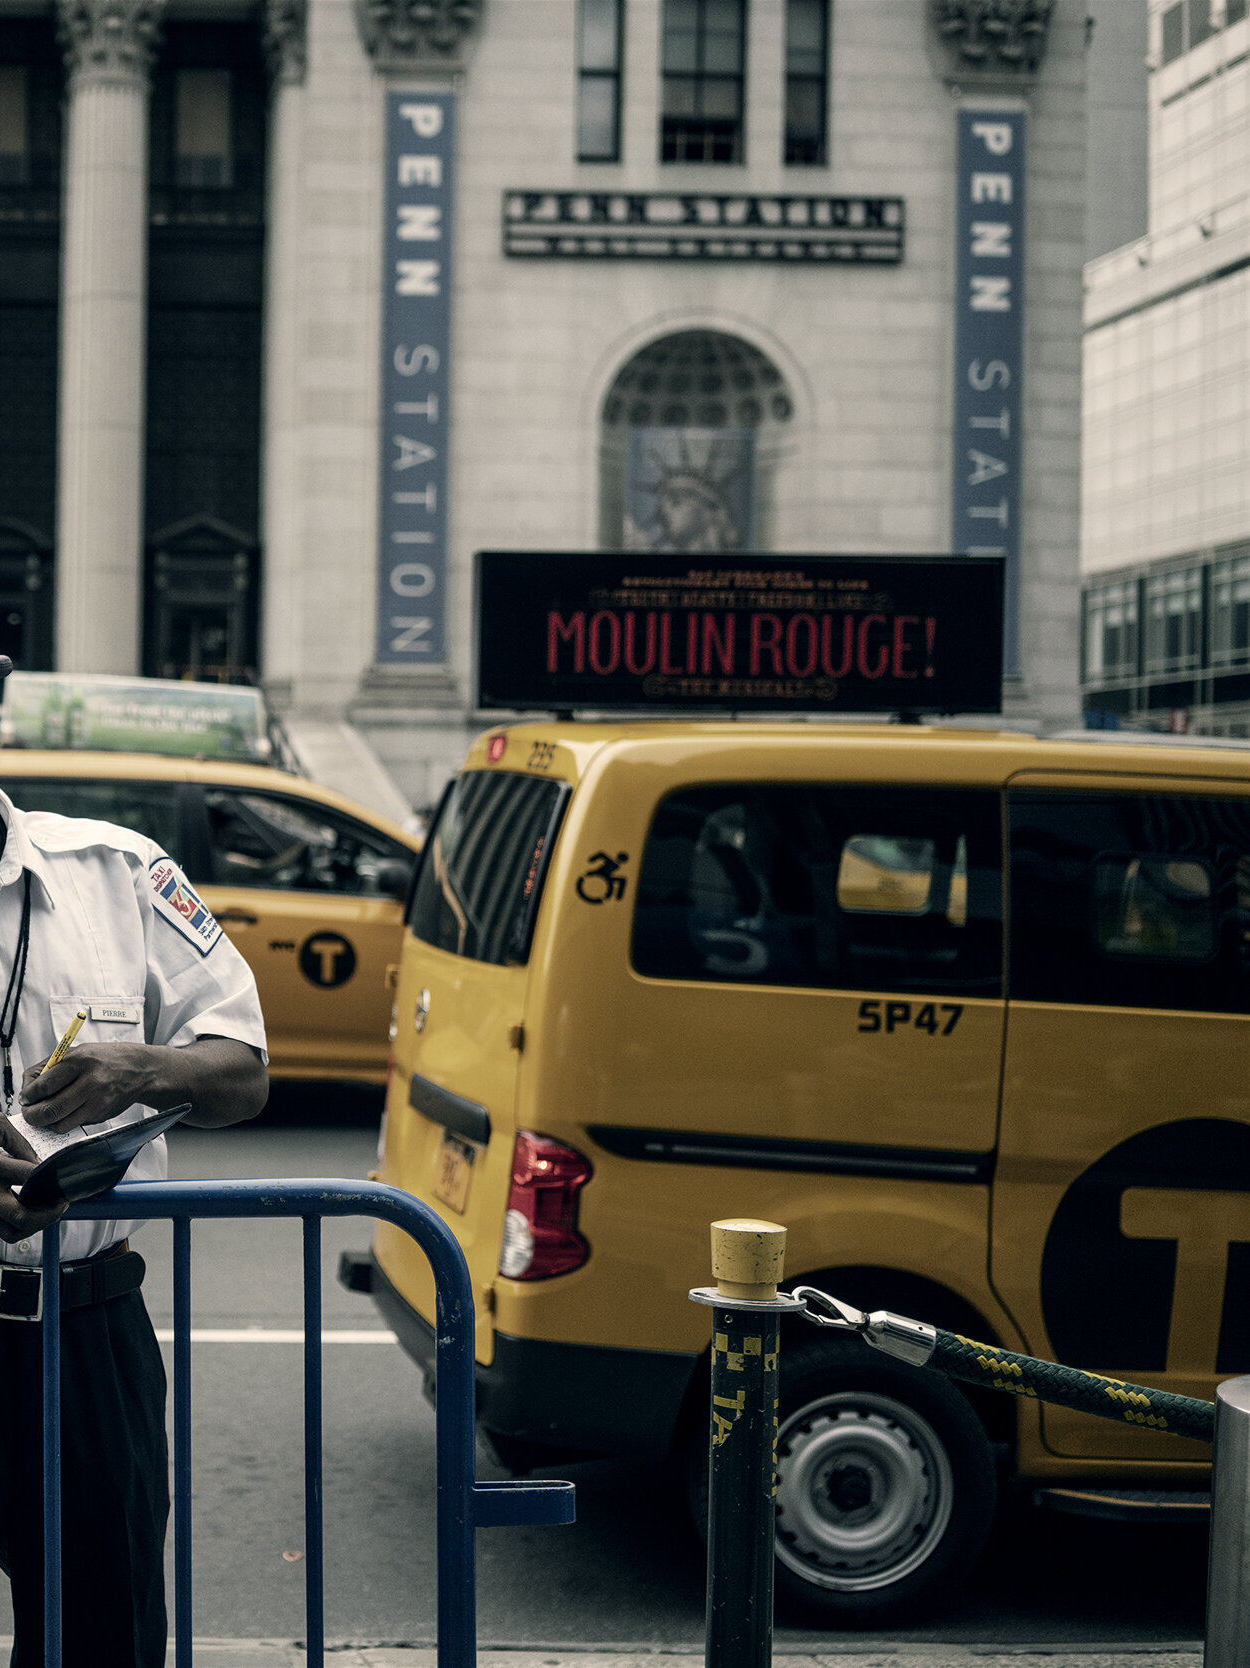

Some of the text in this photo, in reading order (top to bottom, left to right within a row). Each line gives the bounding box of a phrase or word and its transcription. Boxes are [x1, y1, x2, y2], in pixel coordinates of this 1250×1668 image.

[524, 194, 885, 226] PENN STATION
[966, 123, 1013, 557] PENN STATI
[390, 104, 444, 653] PENN STATION
[547, 610, 937, 679] MOULIN ROUGE!
[151, 865, 166, 883] TAXI
[153, 868, 173, 892] DISPATCHER
[310, 940, 345, 983] T
[102, 1009, 127, 1018] PIERRE
[1118, 1185, 1250, 1374] T
